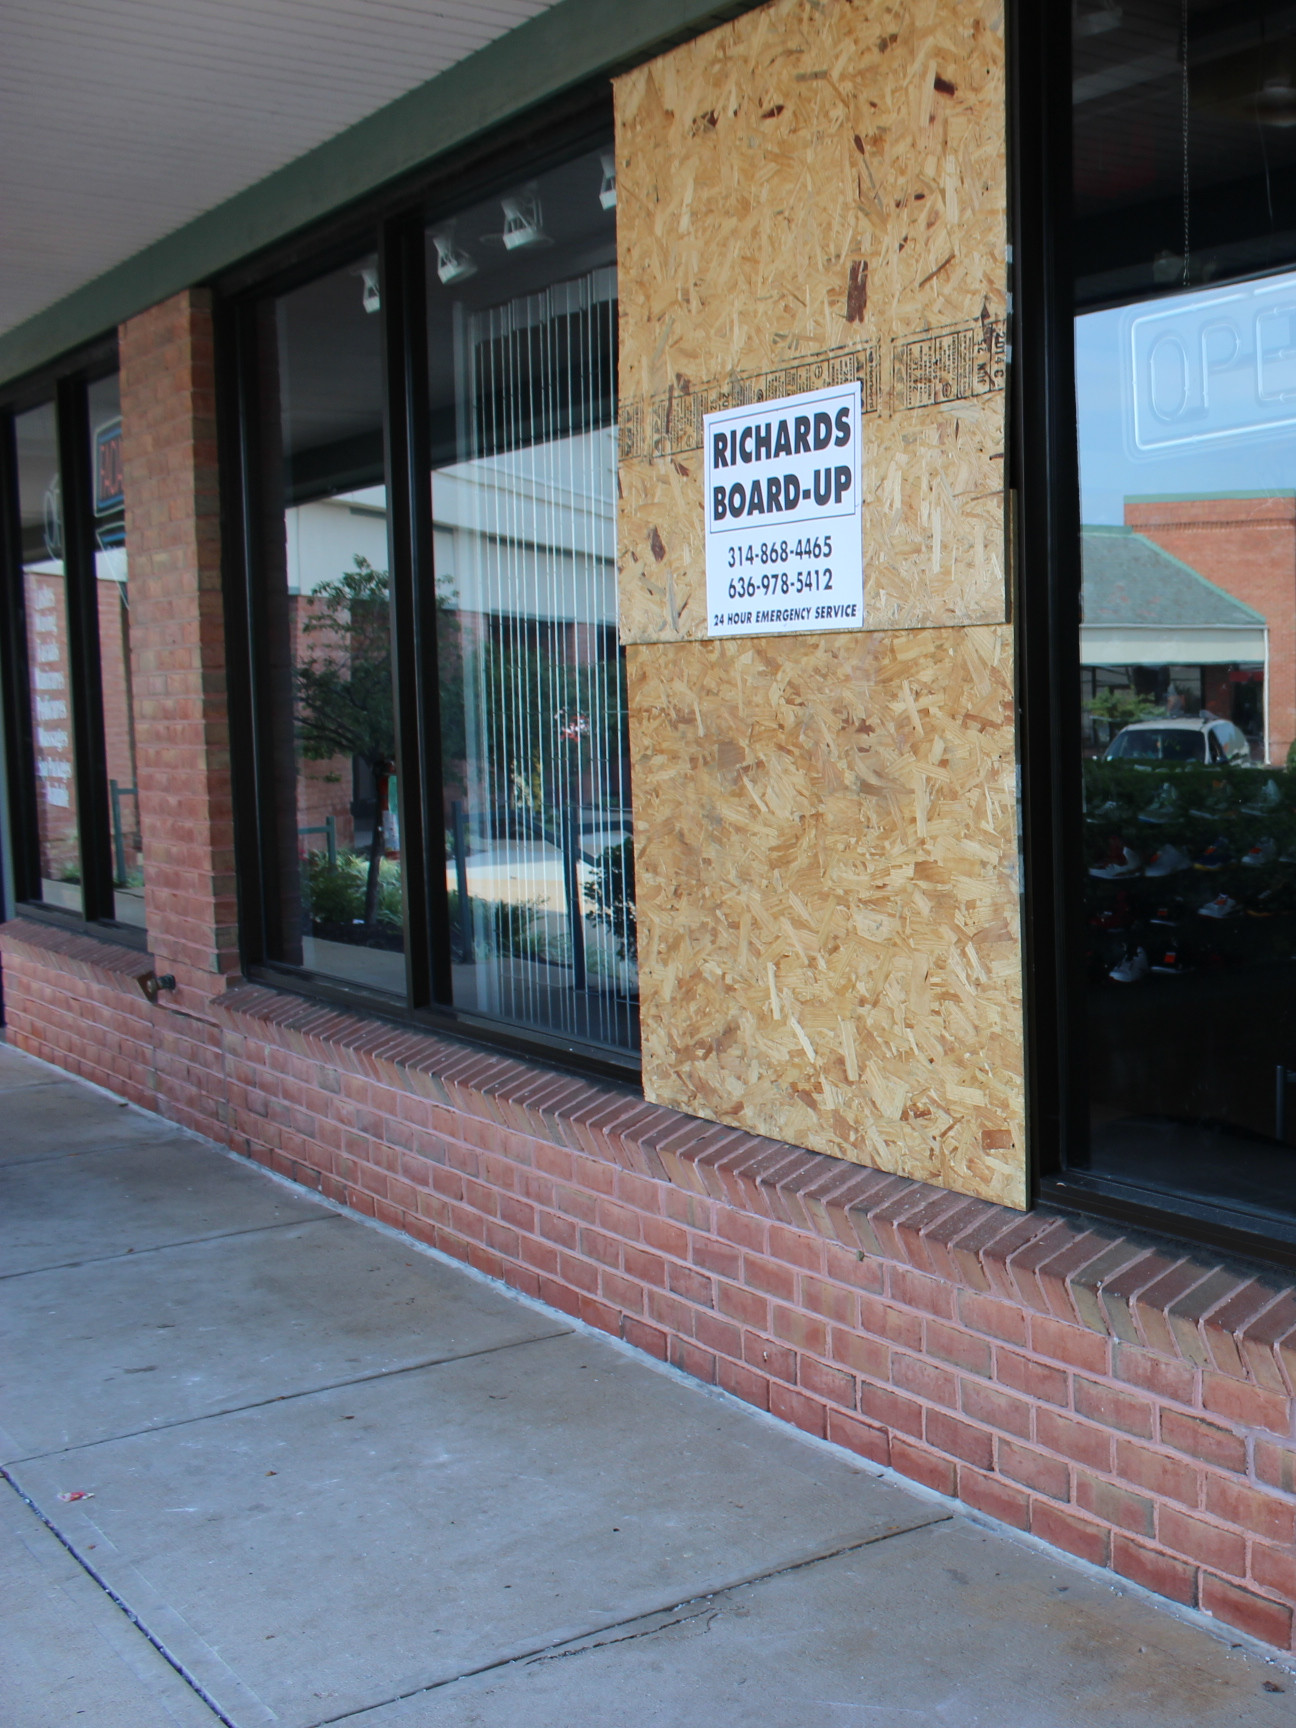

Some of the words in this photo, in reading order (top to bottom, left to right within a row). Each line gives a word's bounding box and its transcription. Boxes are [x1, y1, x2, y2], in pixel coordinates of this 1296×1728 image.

[713, 407, 850, 468] RICHARDS
[713, 466, 852, 520] BOARD-UP
[728, 536, 833, 567] 314-868-4465
[728, 568, 833, 598] 636-978-5412
[714, 614, 724, 626] 24
[727, 611, 752, 625] HOUR
[755, 607, 811, 624] EMERGENCY
[815, 604, 857, 619] SERVICE
